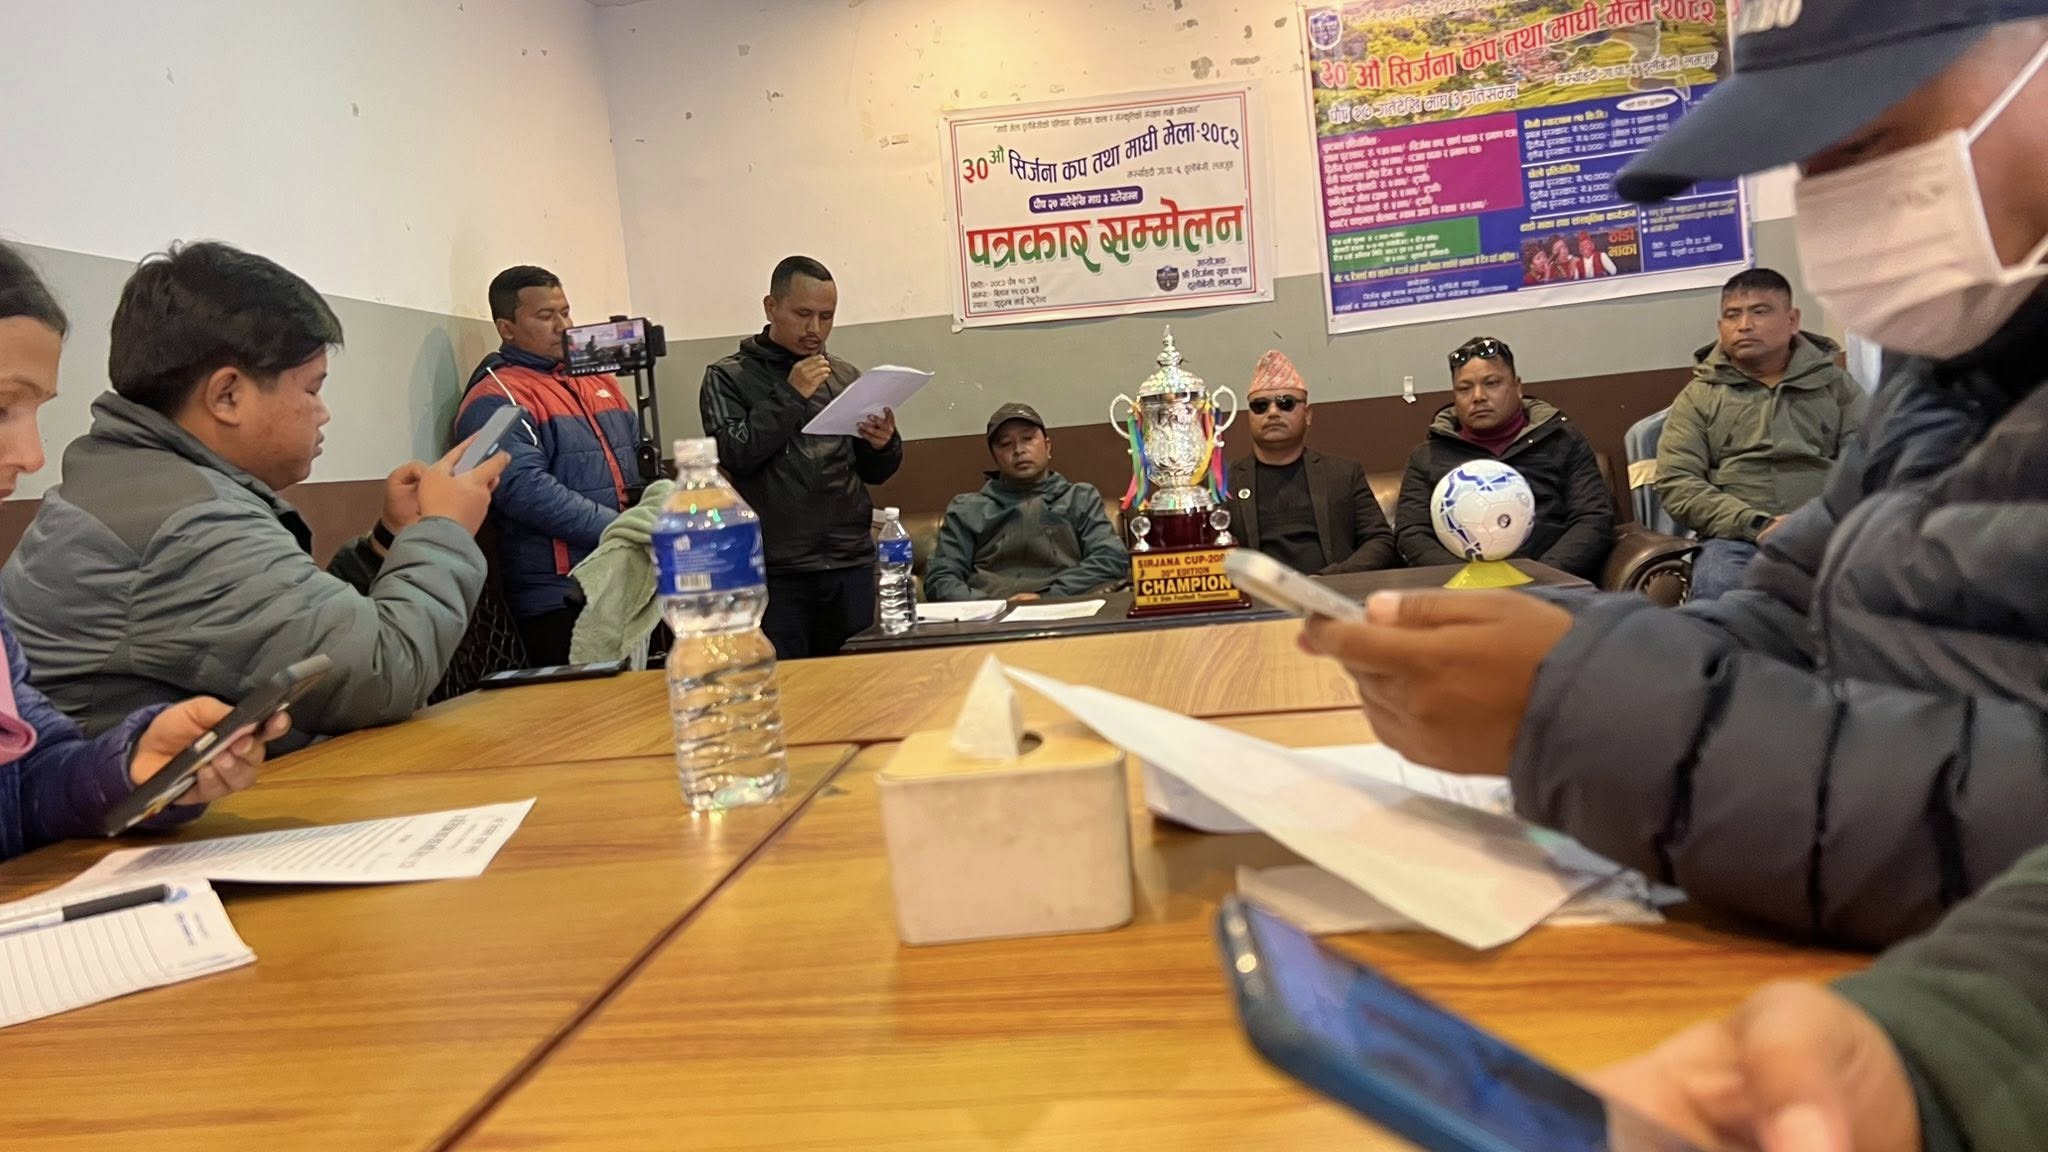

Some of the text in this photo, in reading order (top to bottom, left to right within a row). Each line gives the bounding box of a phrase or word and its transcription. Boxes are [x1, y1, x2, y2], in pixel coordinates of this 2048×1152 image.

[1320, 60, 1346, 87] ३०
[1389, 53, 1456, 87] सिर्जना
[1463, 39, 1498, 68] कप
[1503, 23, 1545, 57] तथा
[1550, 1, 1599, 39] माघी
[1424, 94, 1449, 110] माघ
[1008, 149, 1058, 183] सिर्जना
[1061, 157, 1088, 181] कप
[1092, 145, 1121, 174] तथा
[1125, 125, 1159, 159] माघी
[1088, 194, 1102, 204] माघ
[966, 197, 1244, 274] पत्रकार सम्मेलन
[1137, 557, 1180, 569] SIRJANA
[1142, 575, 1232, 595] CHAMPION
